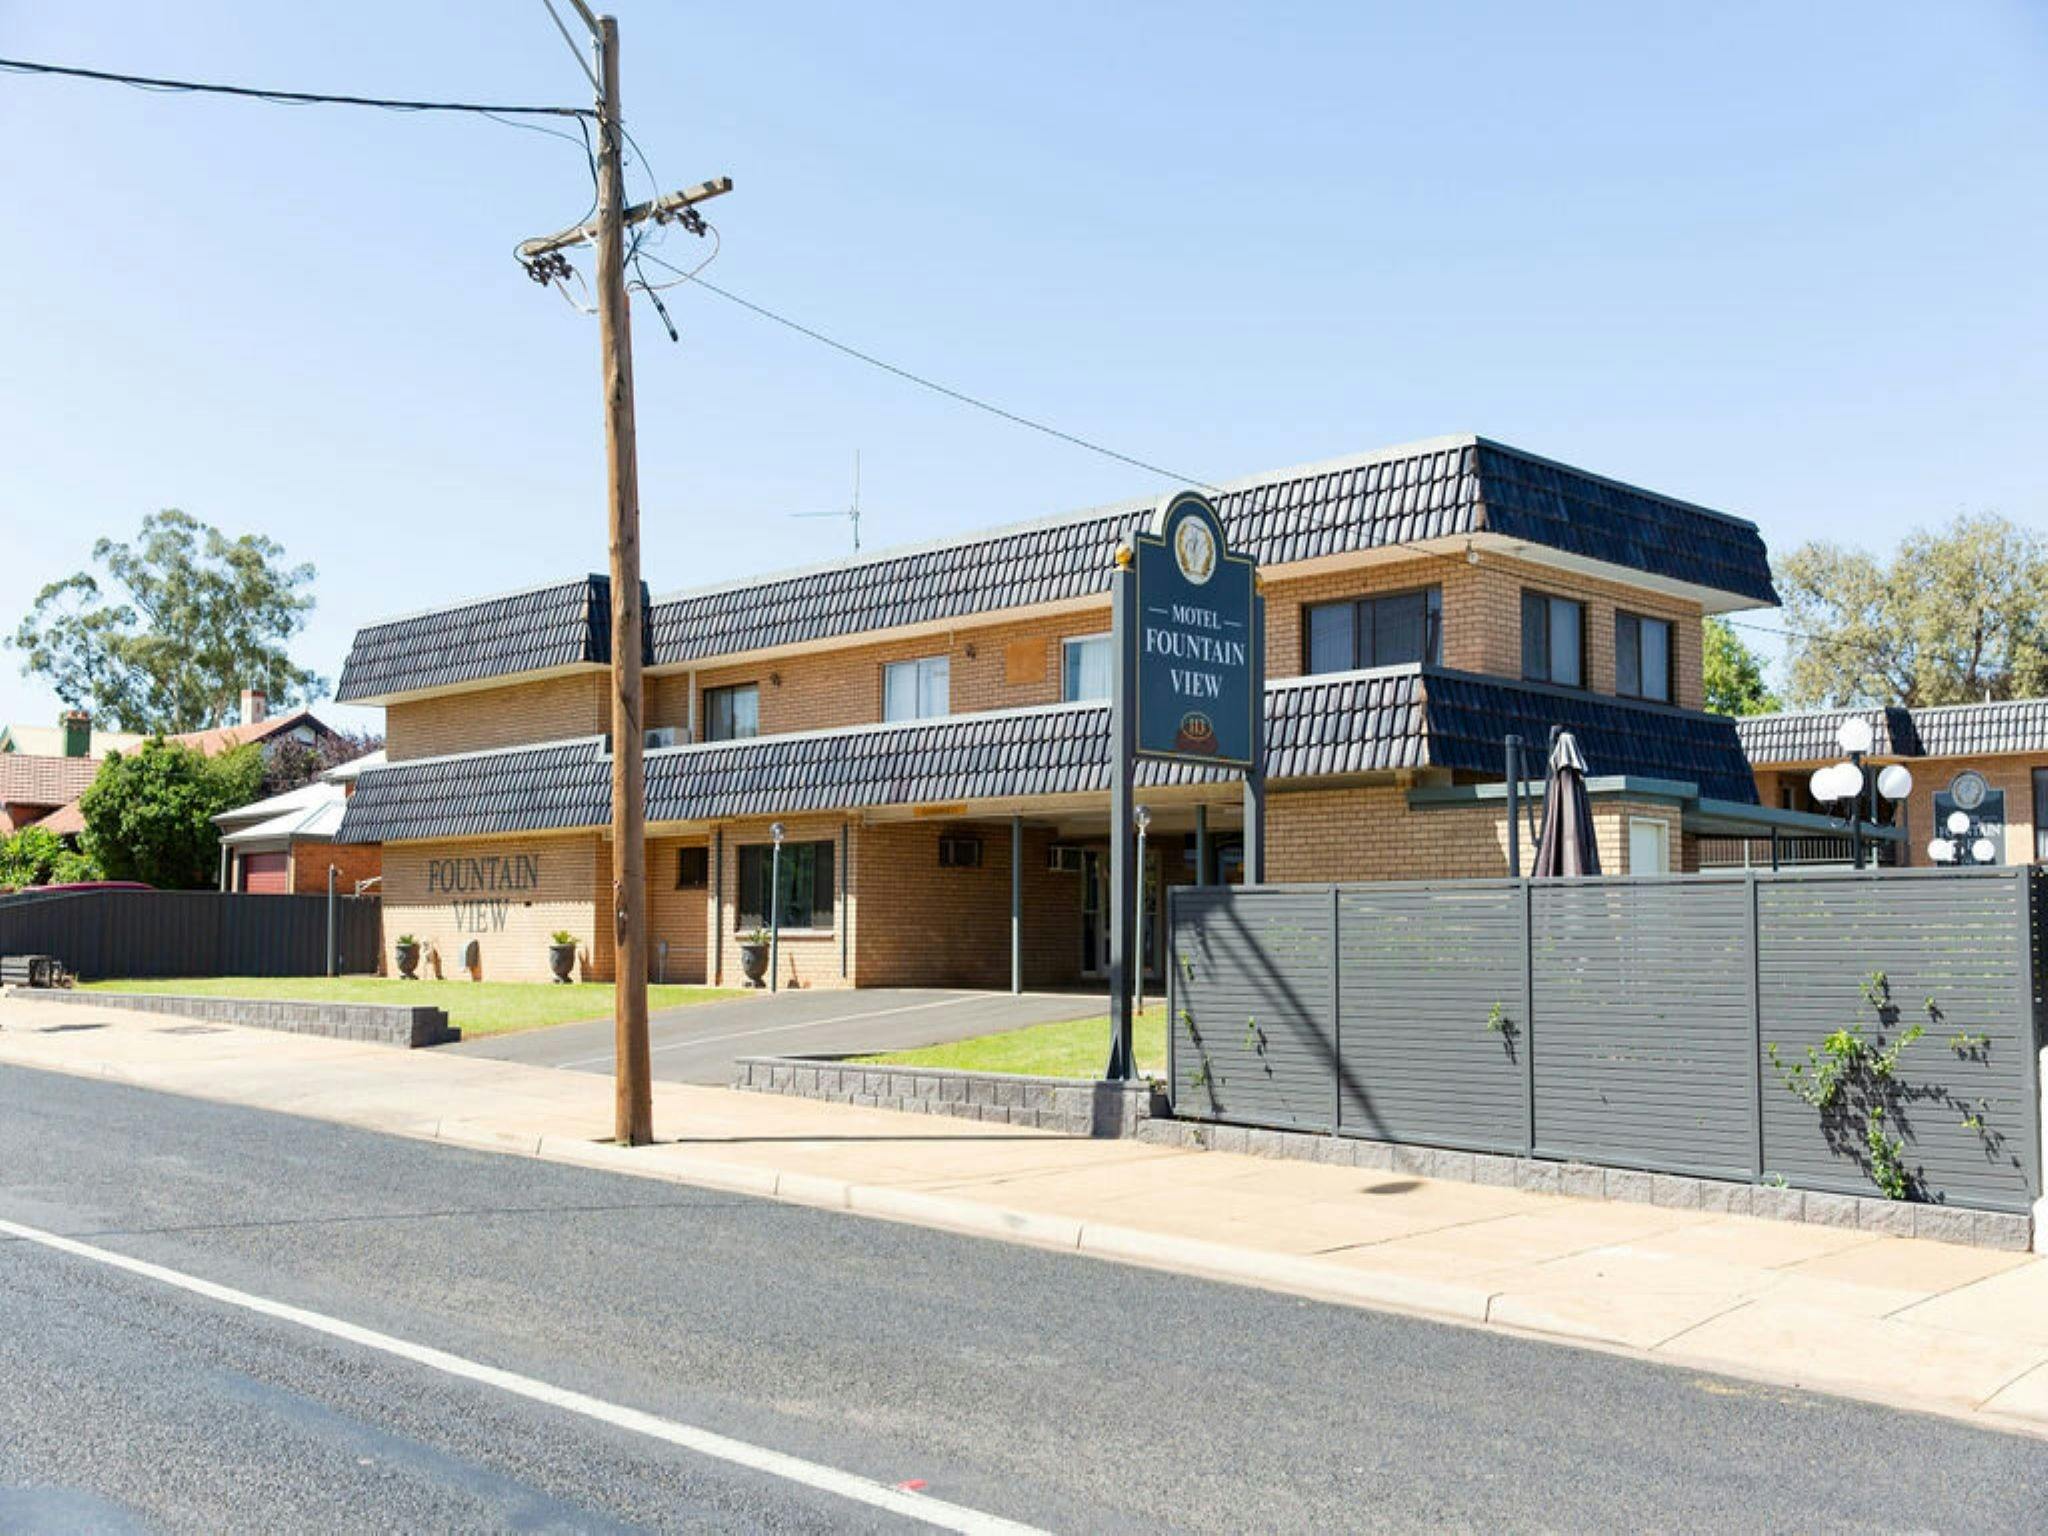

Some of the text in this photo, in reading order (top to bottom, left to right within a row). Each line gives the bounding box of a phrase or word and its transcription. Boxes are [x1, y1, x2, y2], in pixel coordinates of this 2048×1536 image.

[1172, 604, 1222, 630] MOTEL
[1146, 627, 1246, 667] FOUNTAIN
[1170, 668, 1223, 700] VIEW
[428, 853, 540, 893] FOUNTAIN
[452, 898, 511, 933] VIEW
